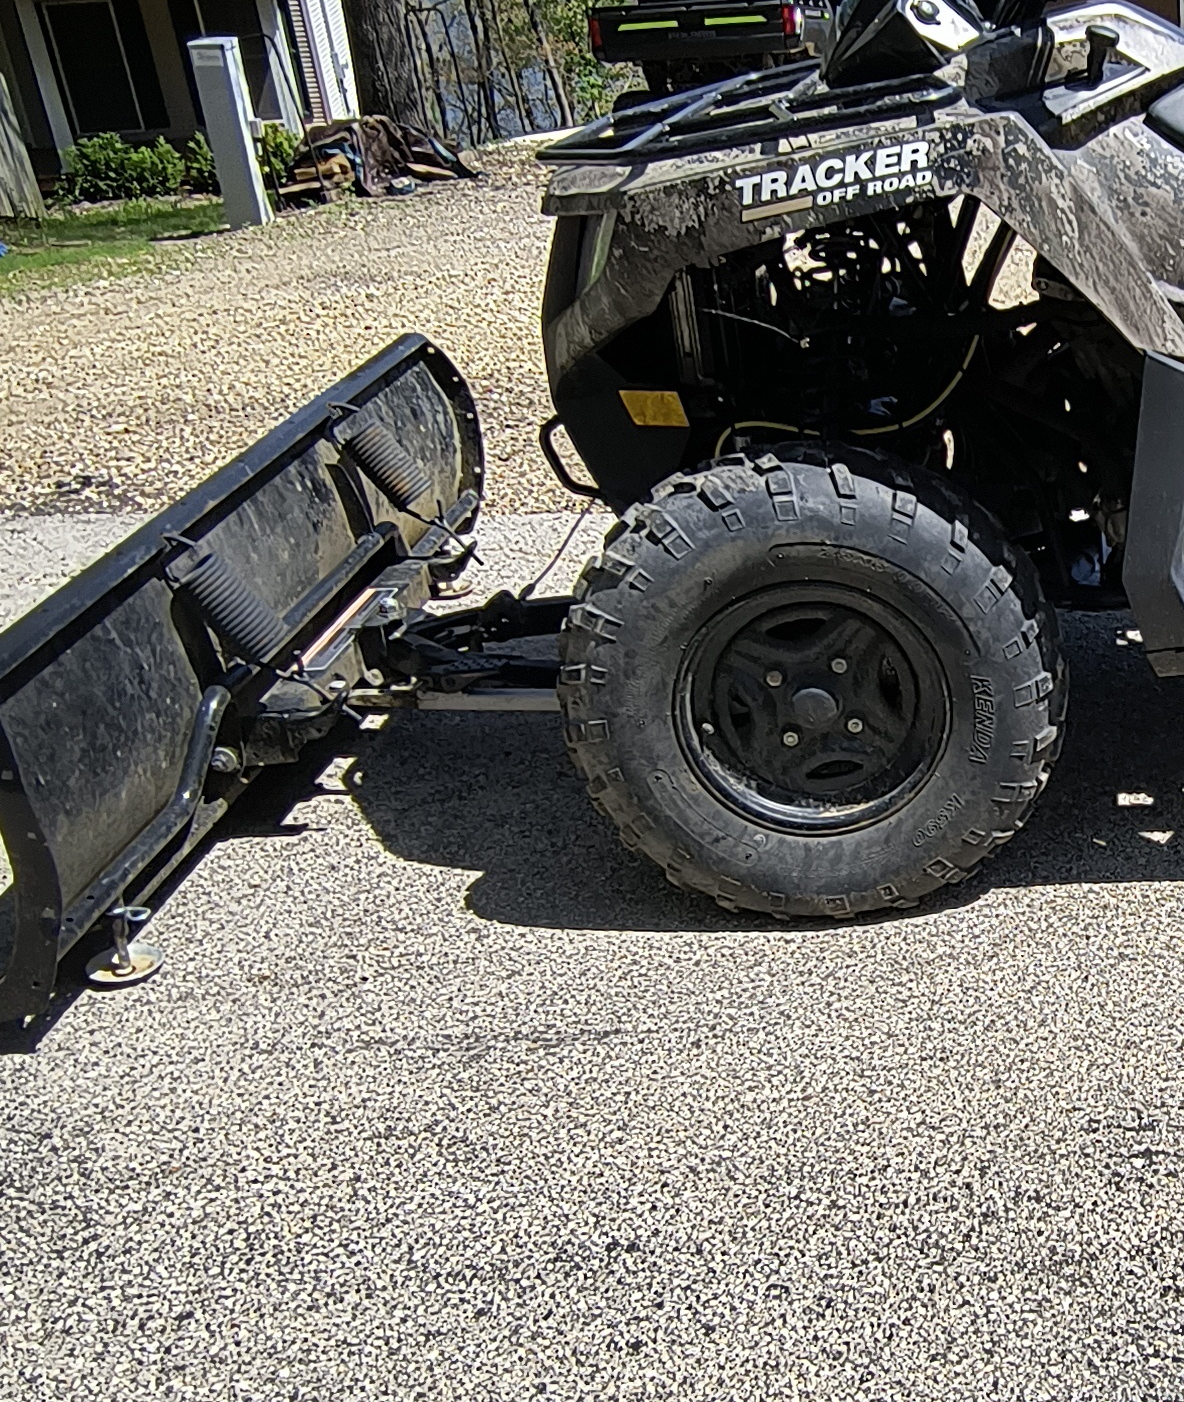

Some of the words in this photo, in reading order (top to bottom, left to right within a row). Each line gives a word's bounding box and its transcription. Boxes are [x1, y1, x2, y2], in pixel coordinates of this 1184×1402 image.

[735, 141, 930, 206] TRACKER
[816, 185, 860, 206] OFF
[867, 171, 933, 196] ROAD
[968, 674, 996, 765] KENDA
